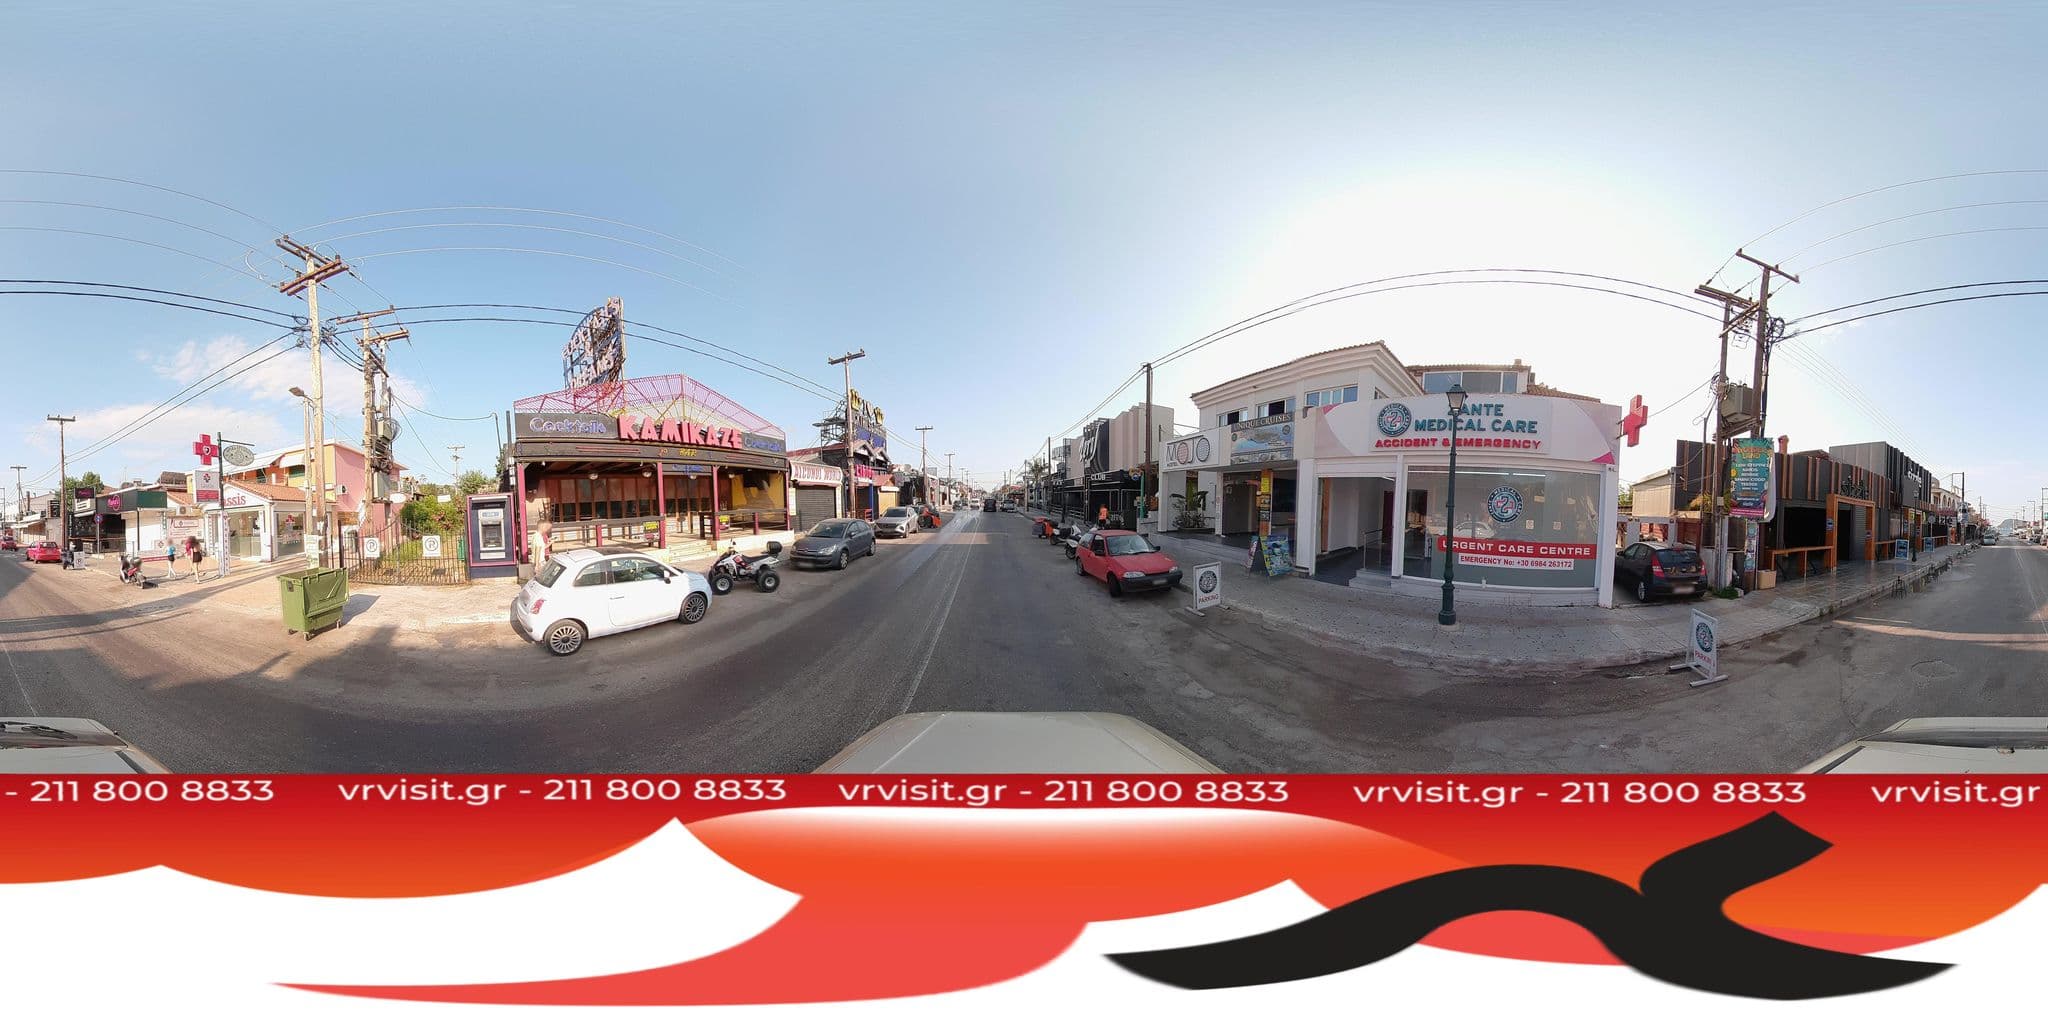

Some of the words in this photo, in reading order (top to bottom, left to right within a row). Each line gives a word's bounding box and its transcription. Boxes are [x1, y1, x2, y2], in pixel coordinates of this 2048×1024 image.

[1260, 413, 1291, 425] CRUISES
[618, 414, 743, 449] KAMIKAZE
[1414, 419, 1486, 432] MEDICAL
[1491, 419, 1538, 433] CARE
[1375, 438, 1438, 448] ACCIDENT
[1442, 438, 1450, 447] &
[1455, 438, 1541, 450] EMERGENCY
[1166, 437, 1211, 464] MOJO
[1498, 544, 1534, 554] CARE
[1539, 546, 1591, 555] CENTRE
[1460, 555, 1501, 565] EMERGENCY
[1199, 594, 1219, 604] PARKING
